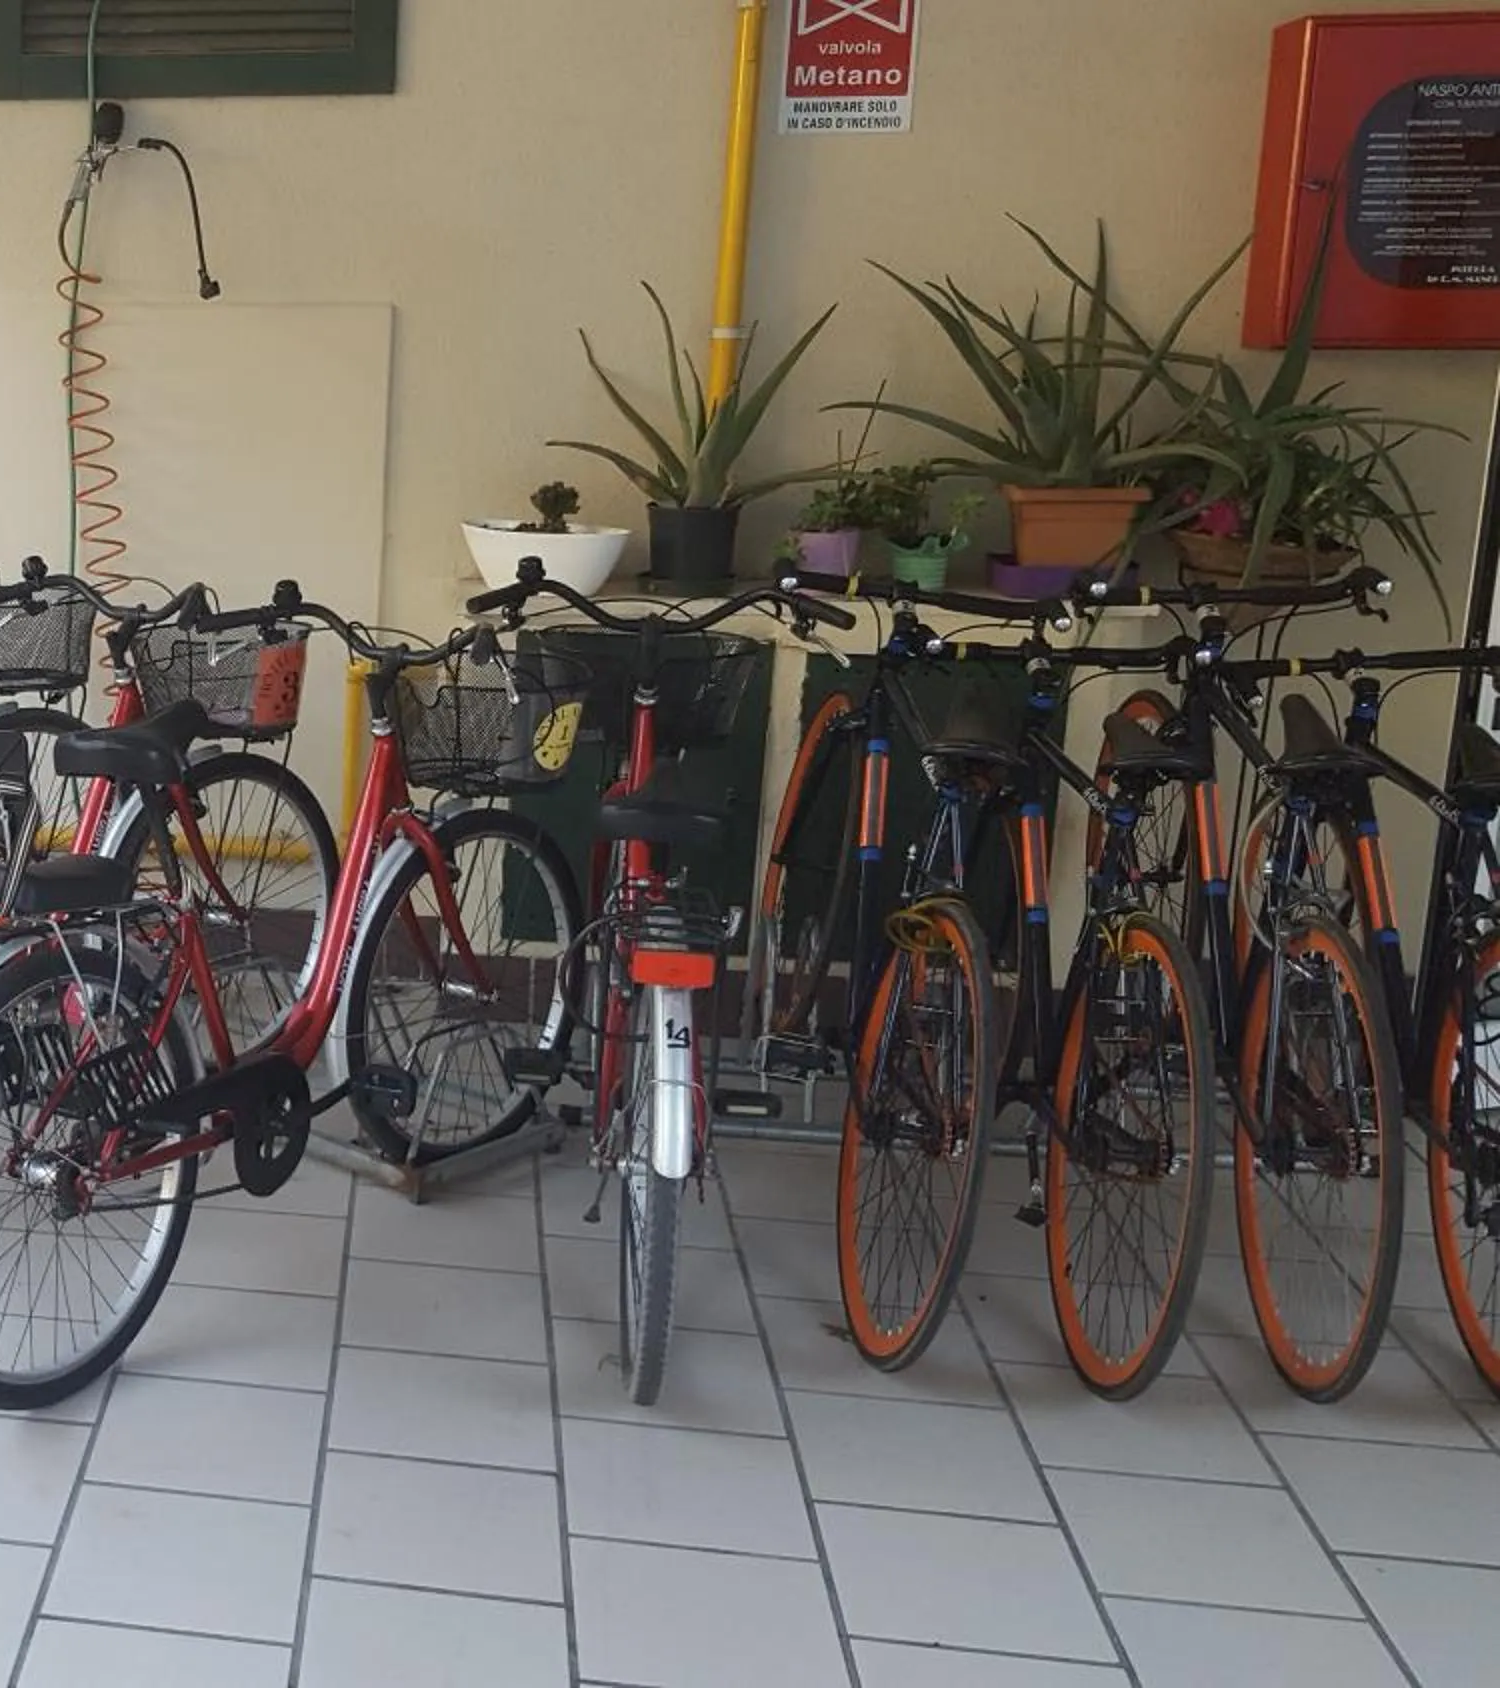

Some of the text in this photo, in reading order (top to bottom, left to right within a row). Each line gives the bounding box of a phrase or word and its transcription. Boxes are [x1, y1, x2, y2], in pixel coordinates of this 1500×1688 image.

[819, 40, 881, 55] valvola
[794, 65, 902, 87] Metano
[793, 100, 897, 113] MANOVRARE SOLO
[787, 117, 799, 129] IN
[801, 117, 833, 129] CASO
